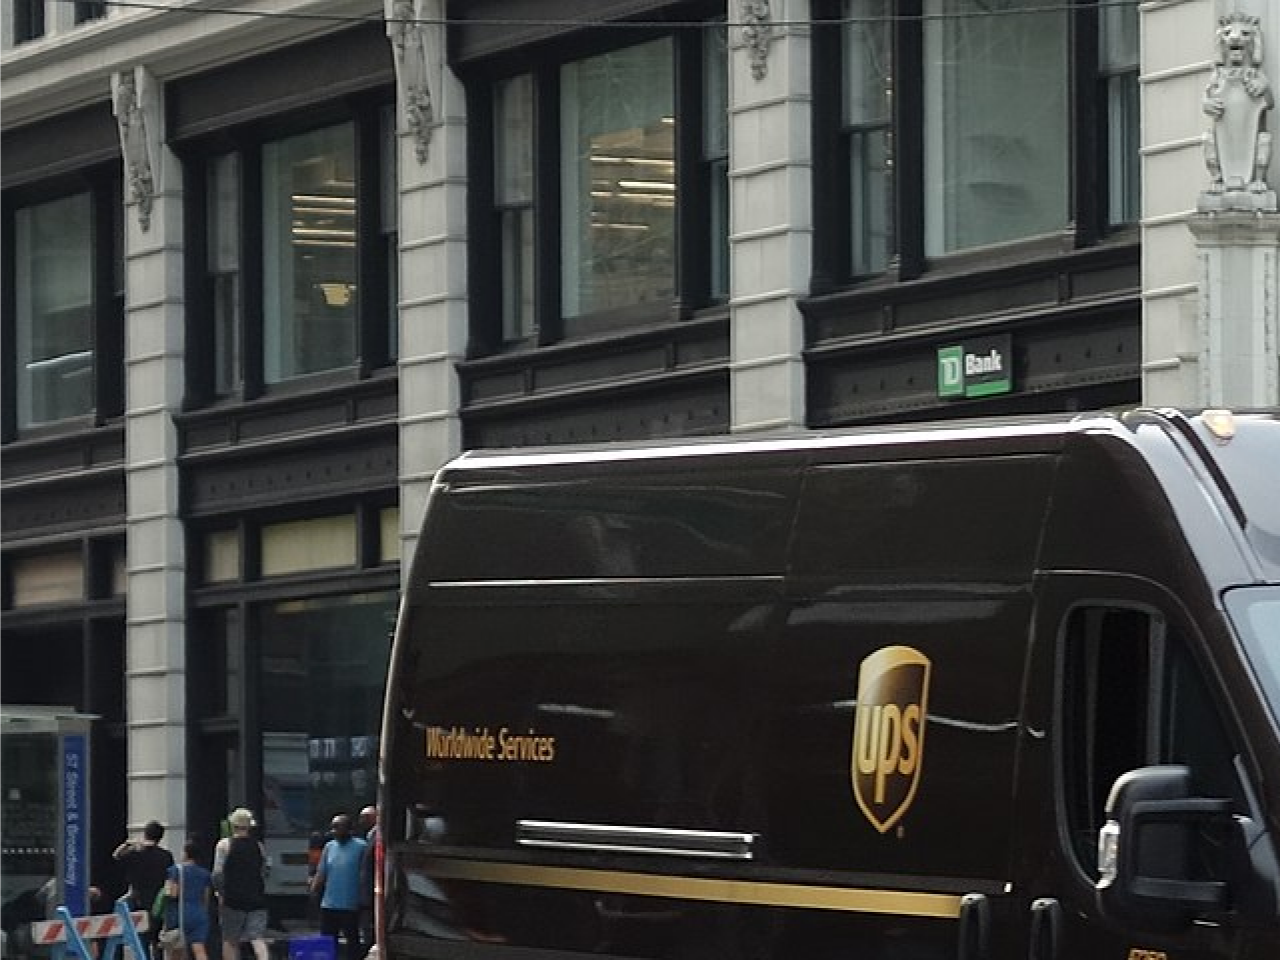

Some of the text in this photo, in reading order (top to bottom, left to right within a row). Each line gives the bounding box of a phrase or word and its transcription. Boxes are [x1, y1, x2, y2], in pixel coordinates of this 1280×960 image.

[965, 350, 1002, 374] Bank
[426, 727, 555, 761] Worldwide Services
[858, 703, 920, 804] ups
